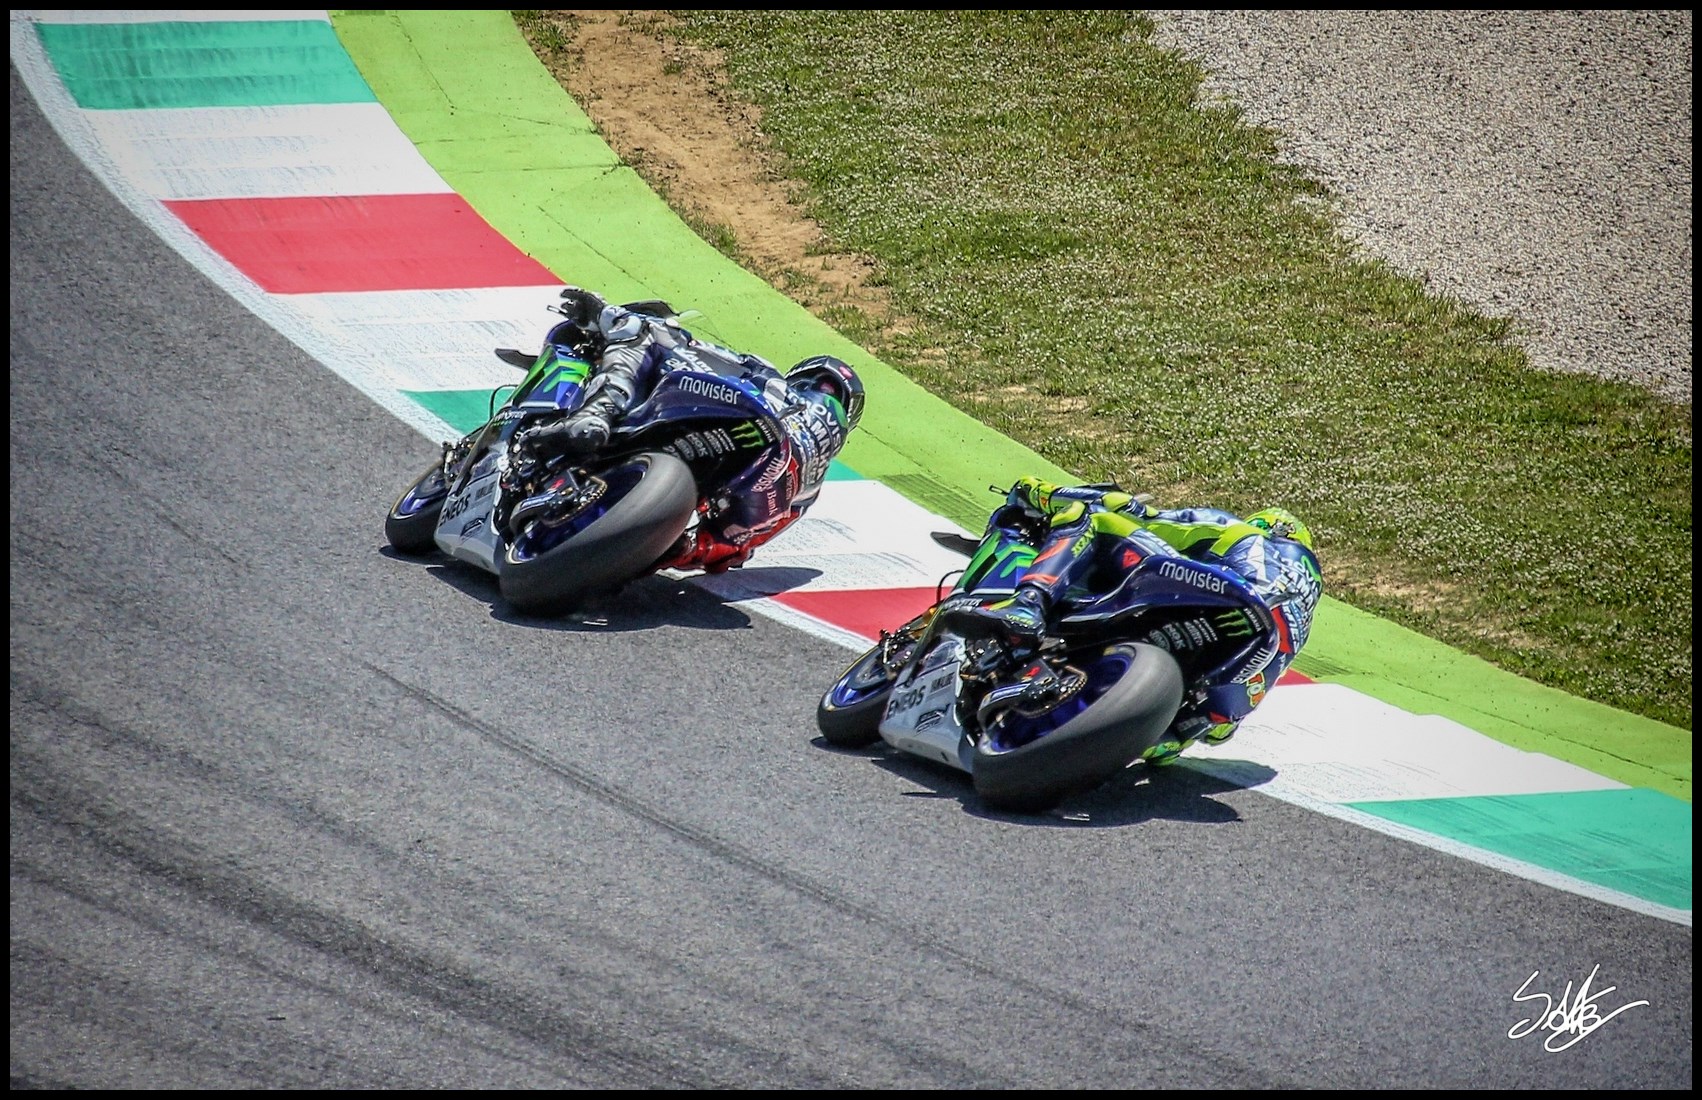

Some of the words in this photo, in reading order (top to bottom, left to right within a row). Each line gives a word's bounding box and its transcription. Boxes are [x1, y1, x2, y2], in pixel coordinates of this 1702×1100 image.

[678, 375, 741, 405] movistar
[755, 419, 775, 443] YAMAHA
[1159, 561, 1228, 595] movistar
[1244, 608, 1263, 632] YAMAHA
